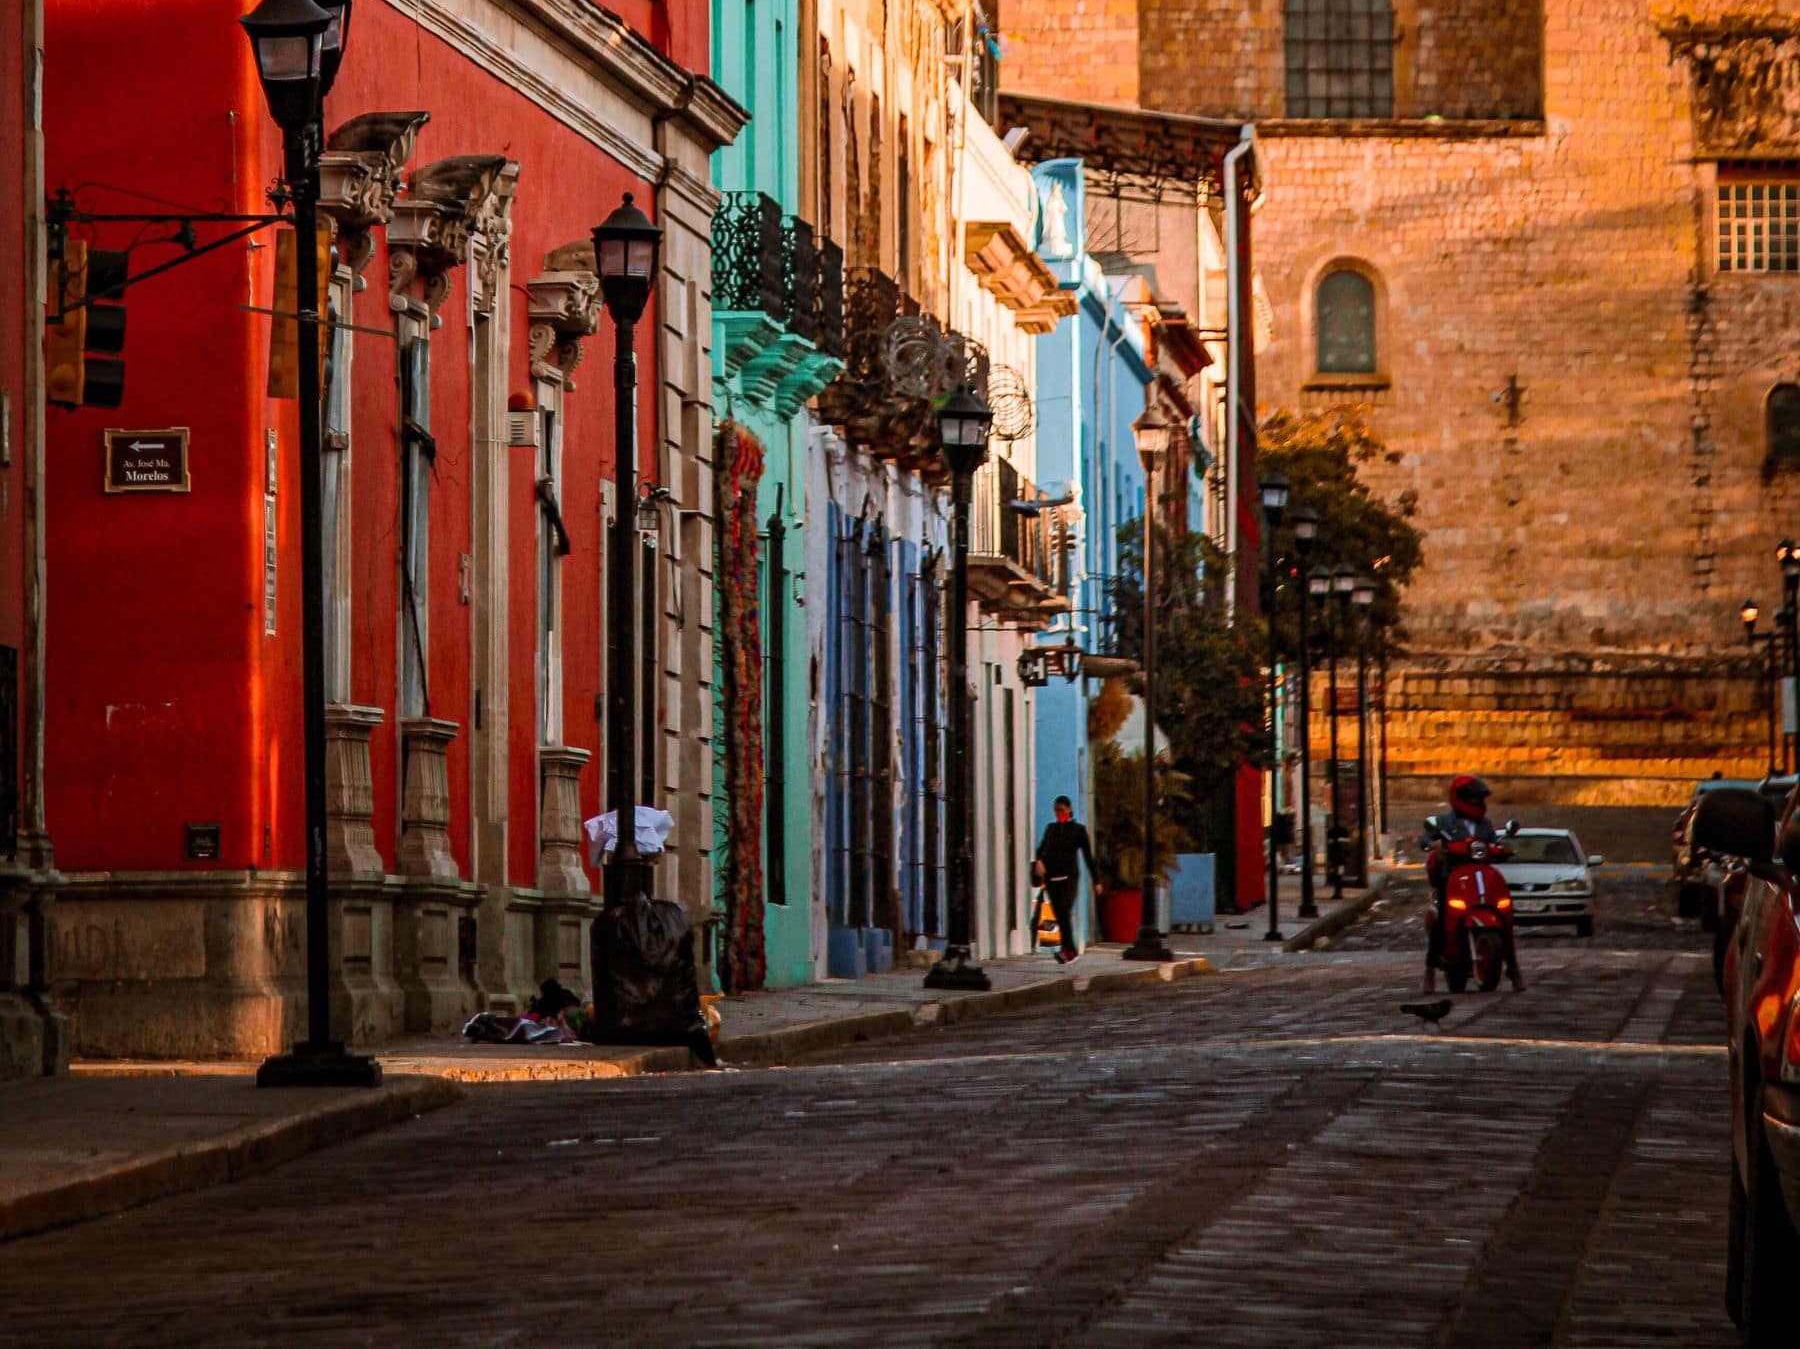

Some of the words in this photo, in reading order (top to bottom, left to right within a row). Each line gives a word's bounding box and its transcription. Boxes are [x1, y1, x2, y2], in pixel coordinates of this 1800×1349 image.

[124, 460, 135, 468] Av.
[138, 459, 154, 468] José
[125, 470, 169, 481] Morelos
